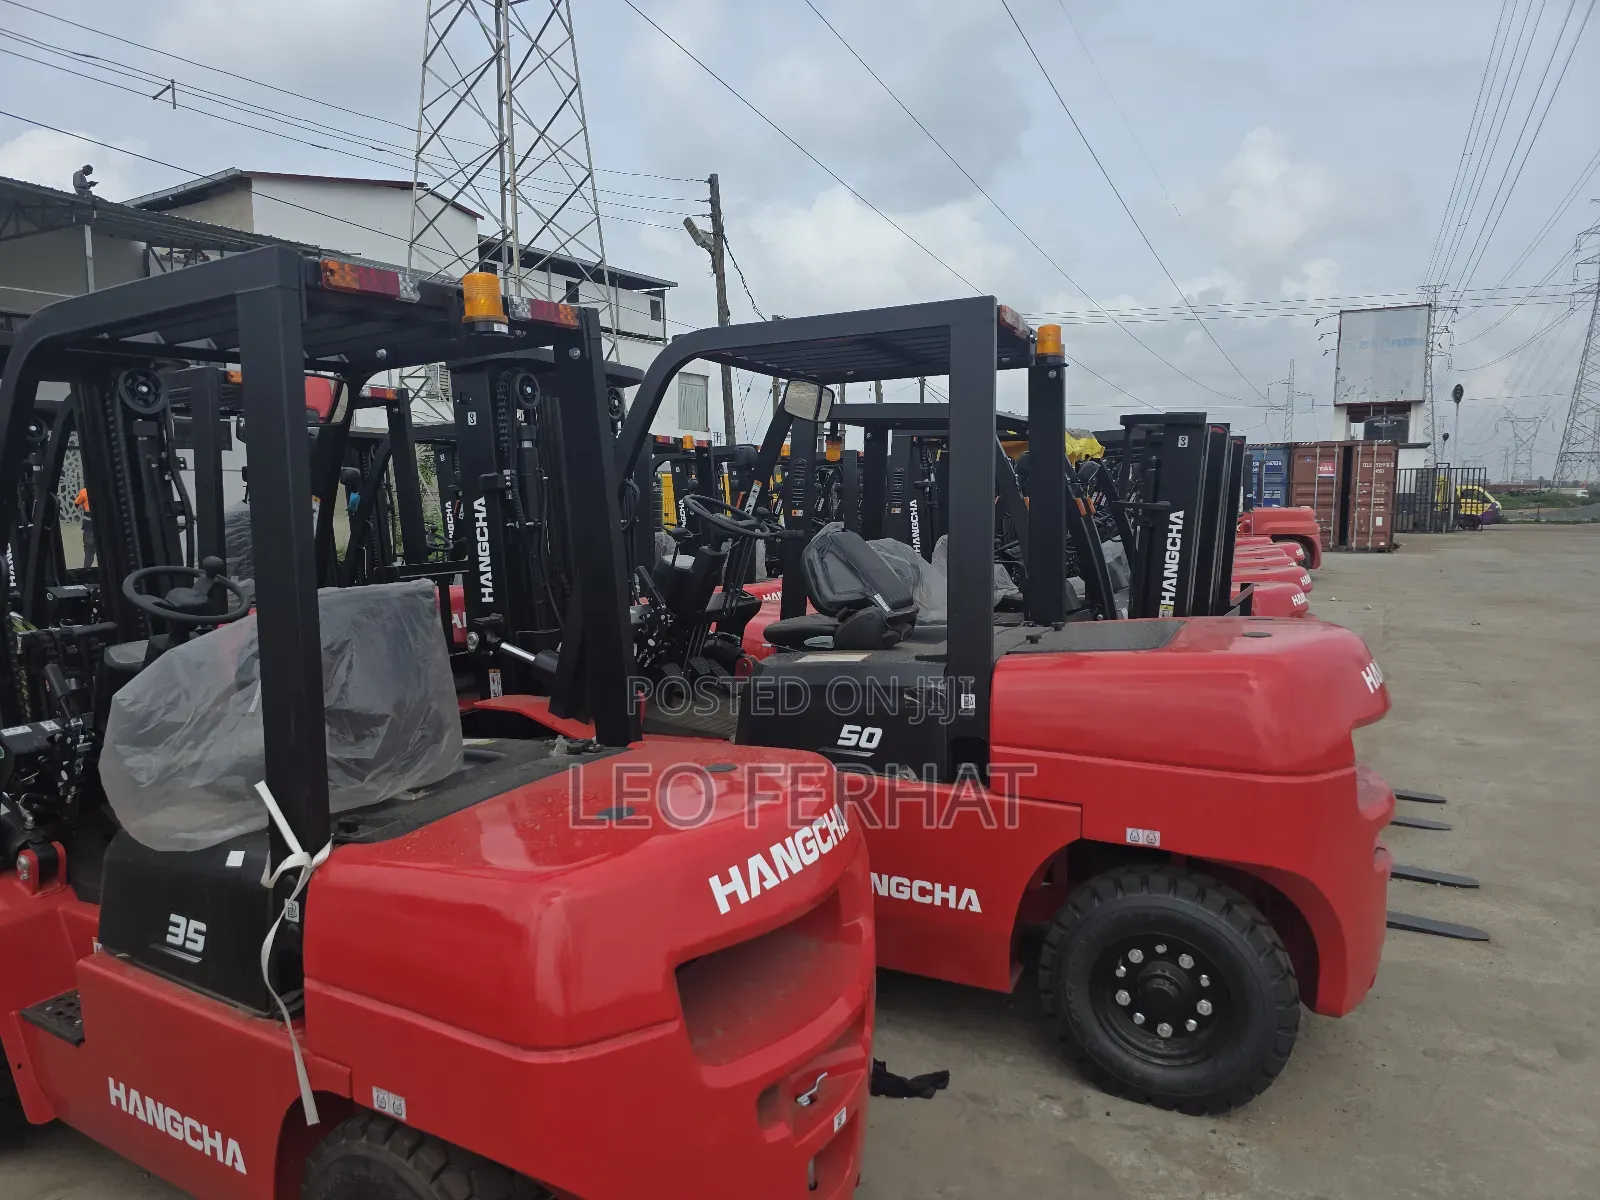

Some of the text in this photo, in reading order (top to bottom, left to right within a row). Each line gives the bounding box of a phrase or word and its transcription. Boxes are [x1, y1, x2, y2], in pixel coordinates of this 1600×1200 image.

[445, 500, 455, 543] NGCHA
[473, 495, 494, 603] HANGCHA
[909, 499, 921, 553] HANGCHA
[1160, 510, 1184, 606] HANGCHA
[836, 724, 883, 749] 50
[708, 802, 850, 915] HANGCHA
[165, 913, 207, 953] 35
[107, 1076, 248, 1175] HANGCHA
